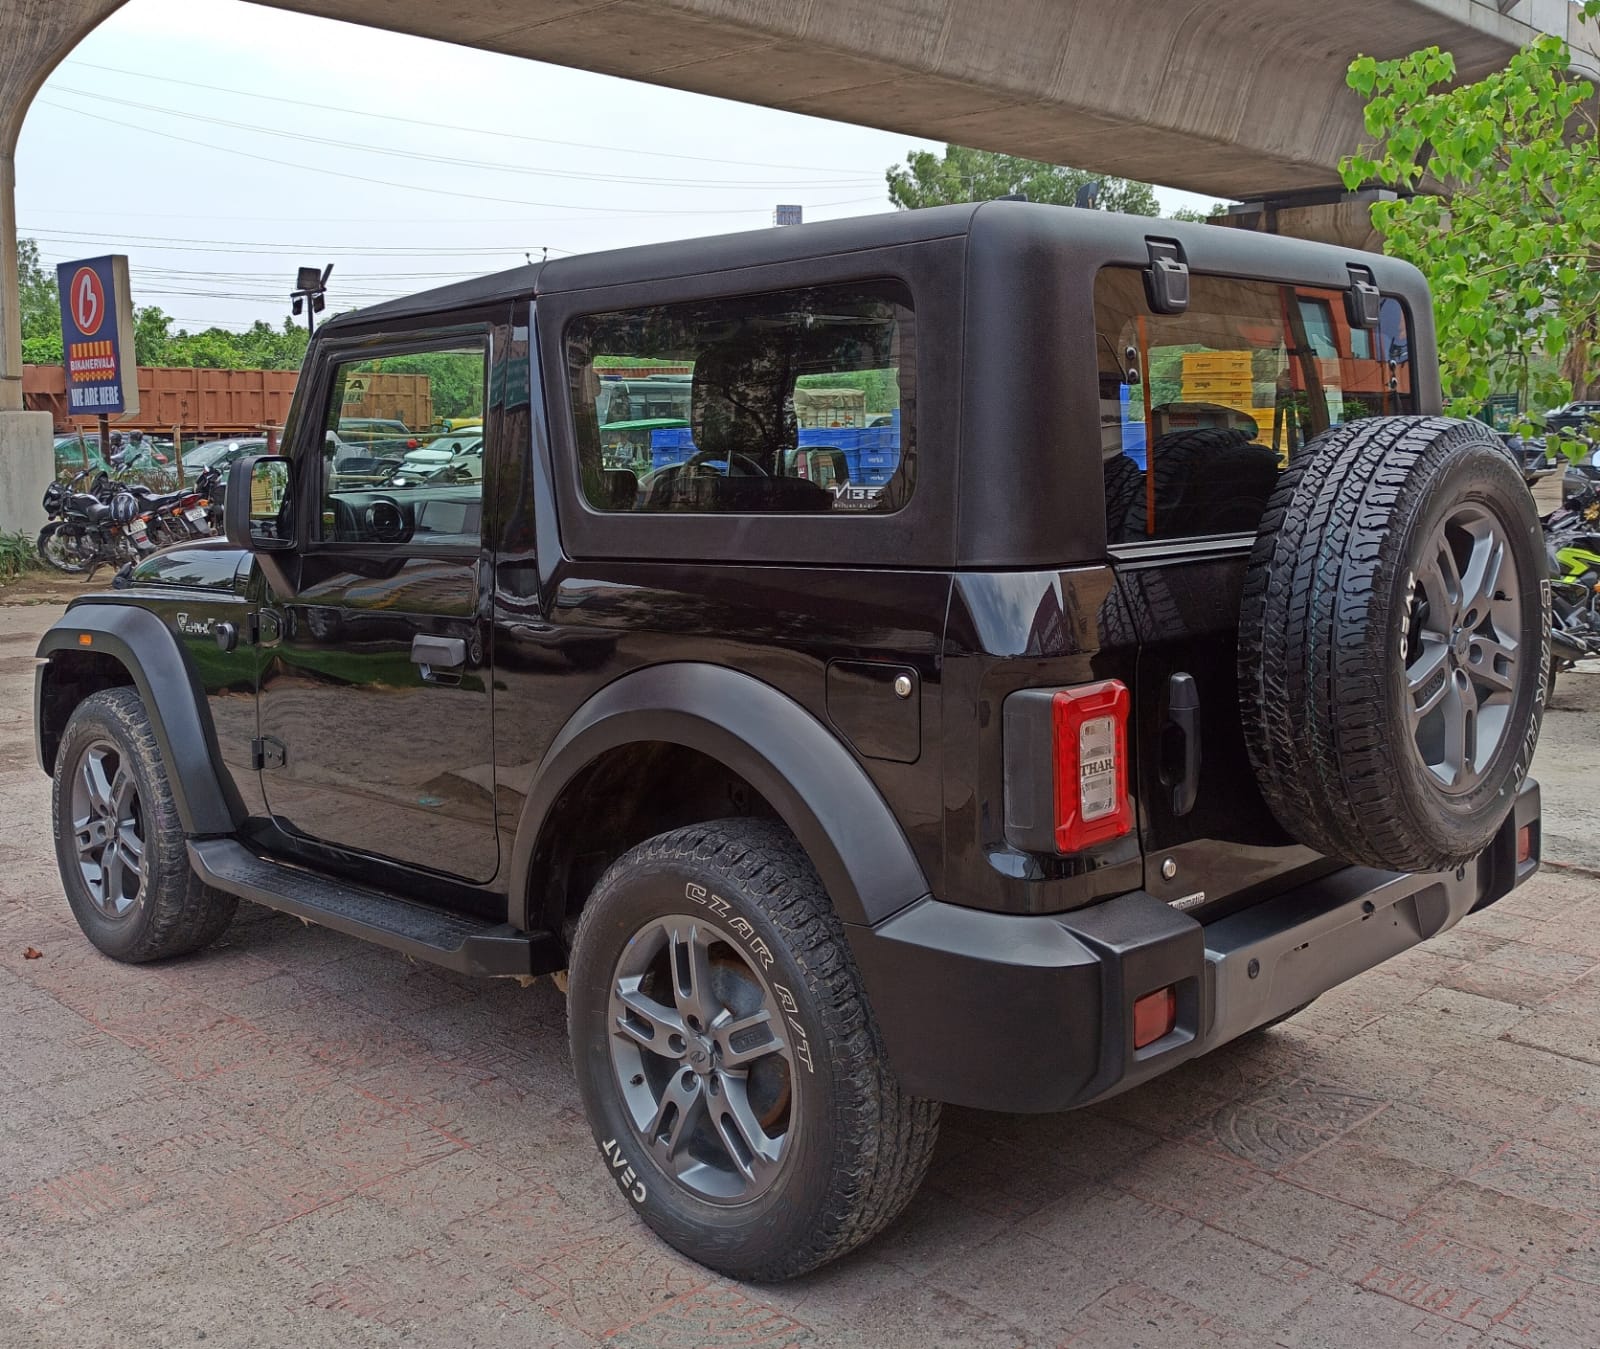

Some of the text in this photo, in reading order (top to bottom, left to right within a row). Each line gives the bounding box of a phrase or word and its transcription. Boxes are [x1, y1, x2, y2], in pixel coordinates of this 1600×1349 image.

[71, 385, 119, 406] WE ARE HERE
[1080, 758, 1115, 776] THAR
[686, 882, 774, 971] CZAR
[774, 983, 815, 1074] A/T
[602, 1138, 647, 1203] CEAT
